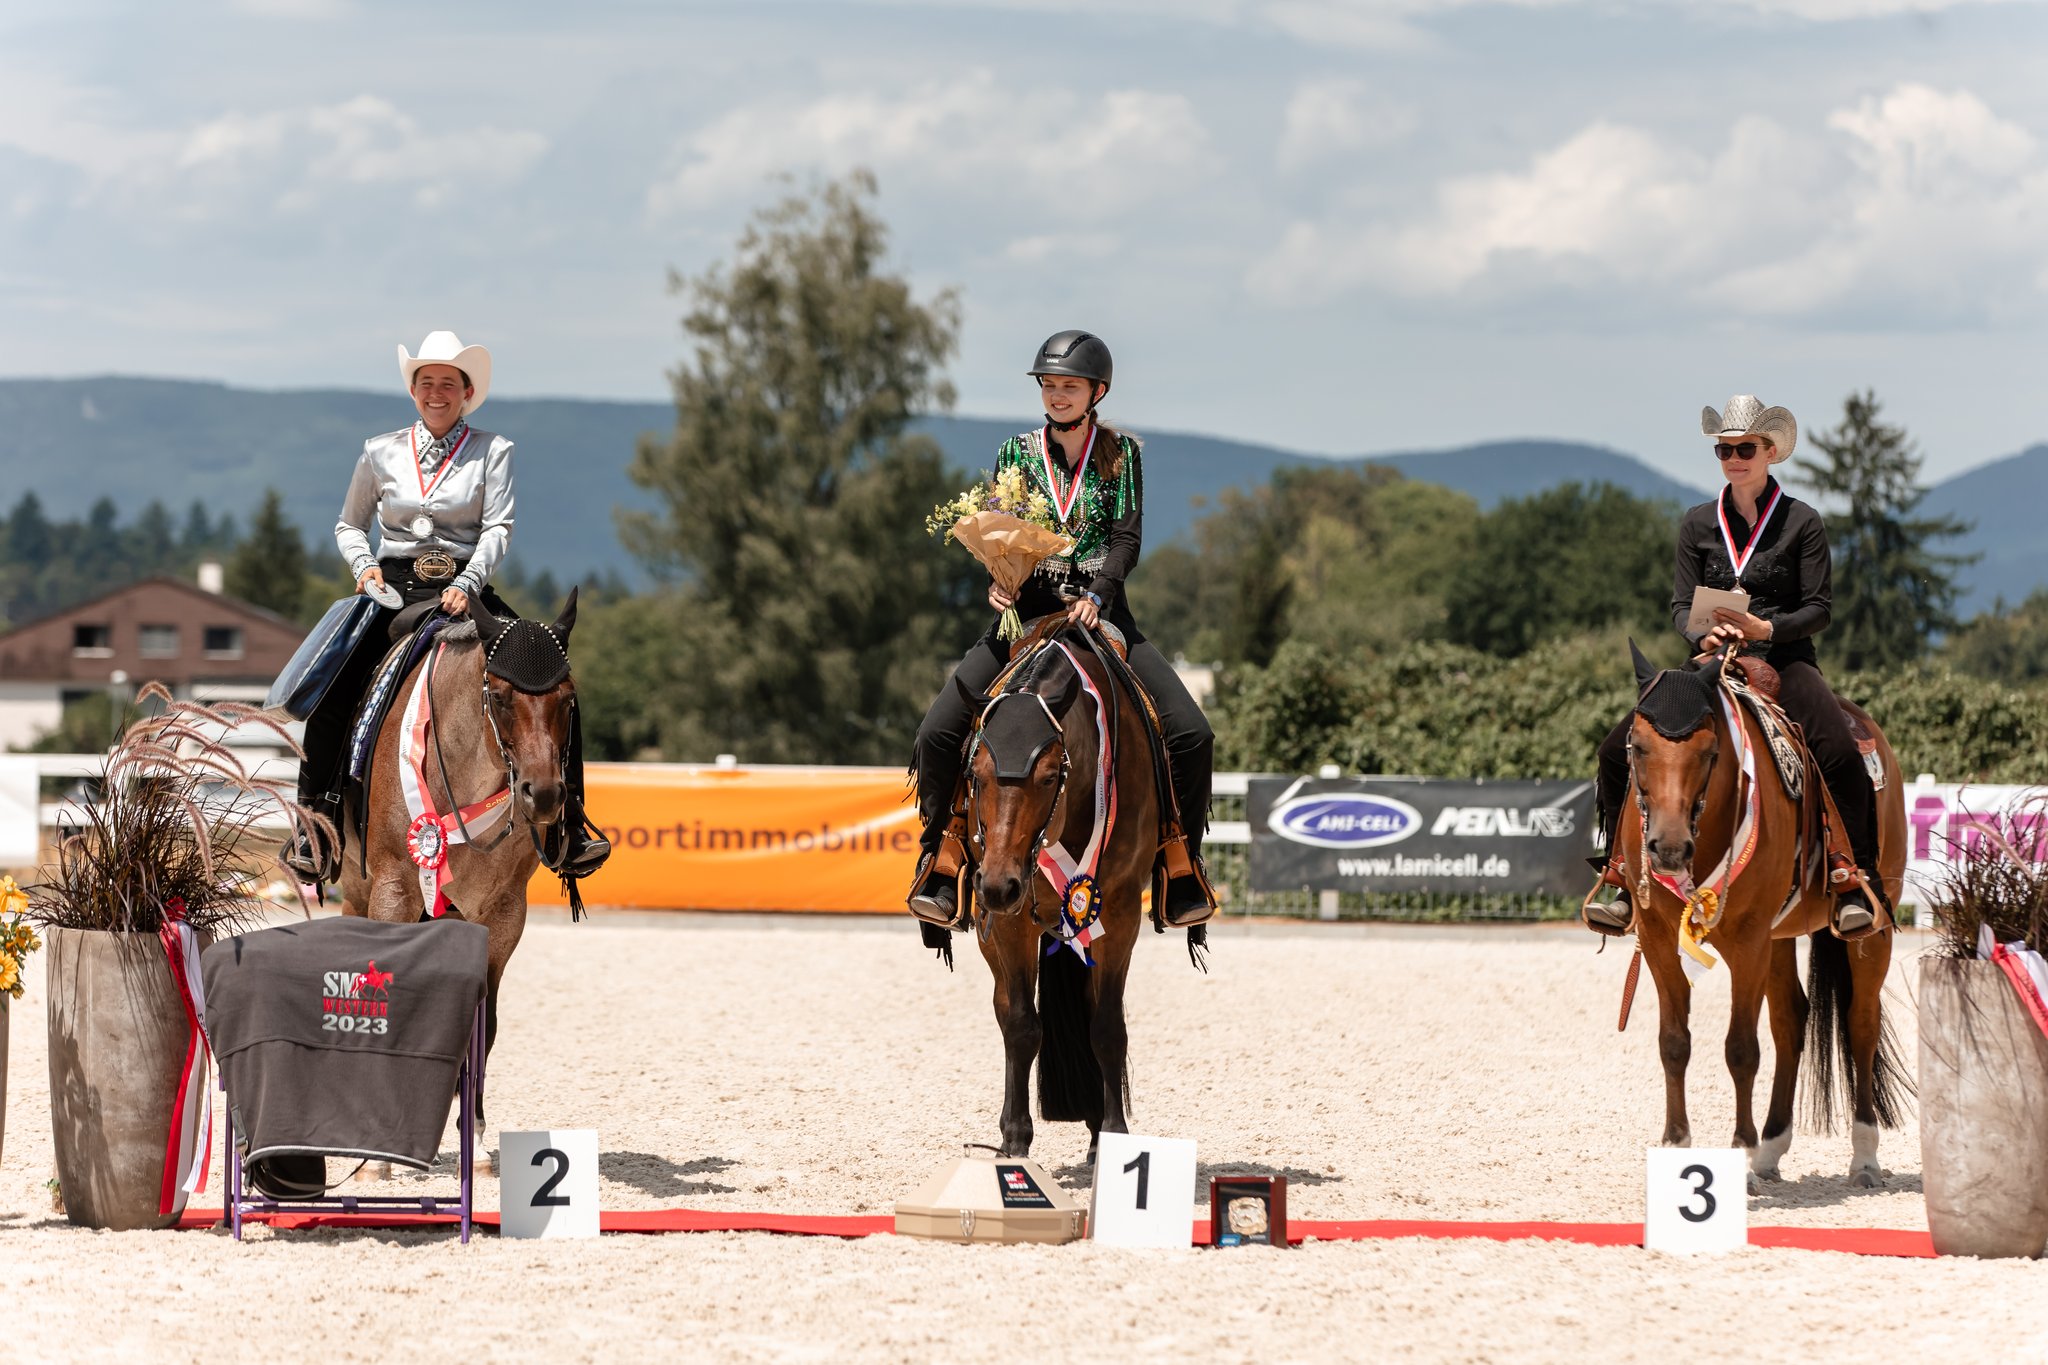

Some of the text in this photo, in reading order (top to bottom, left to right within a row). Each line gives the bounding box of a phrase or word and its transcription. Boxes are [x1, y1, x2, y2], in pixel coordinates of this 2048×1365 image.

[601, 820, 923, 853] portimmobilie
[1337, 853, 1511, 878] www.lamicell.de
[322, 971, 362, 999] SM
[322, 998, 389, 1018] WESTERN
[321, 1013, 389, 1035] 2023
[529, 1147, 571, 1208] 2
[1122, 1151, 1151, 1211] 1
[1677, 1163, 1717, 1223] 3
